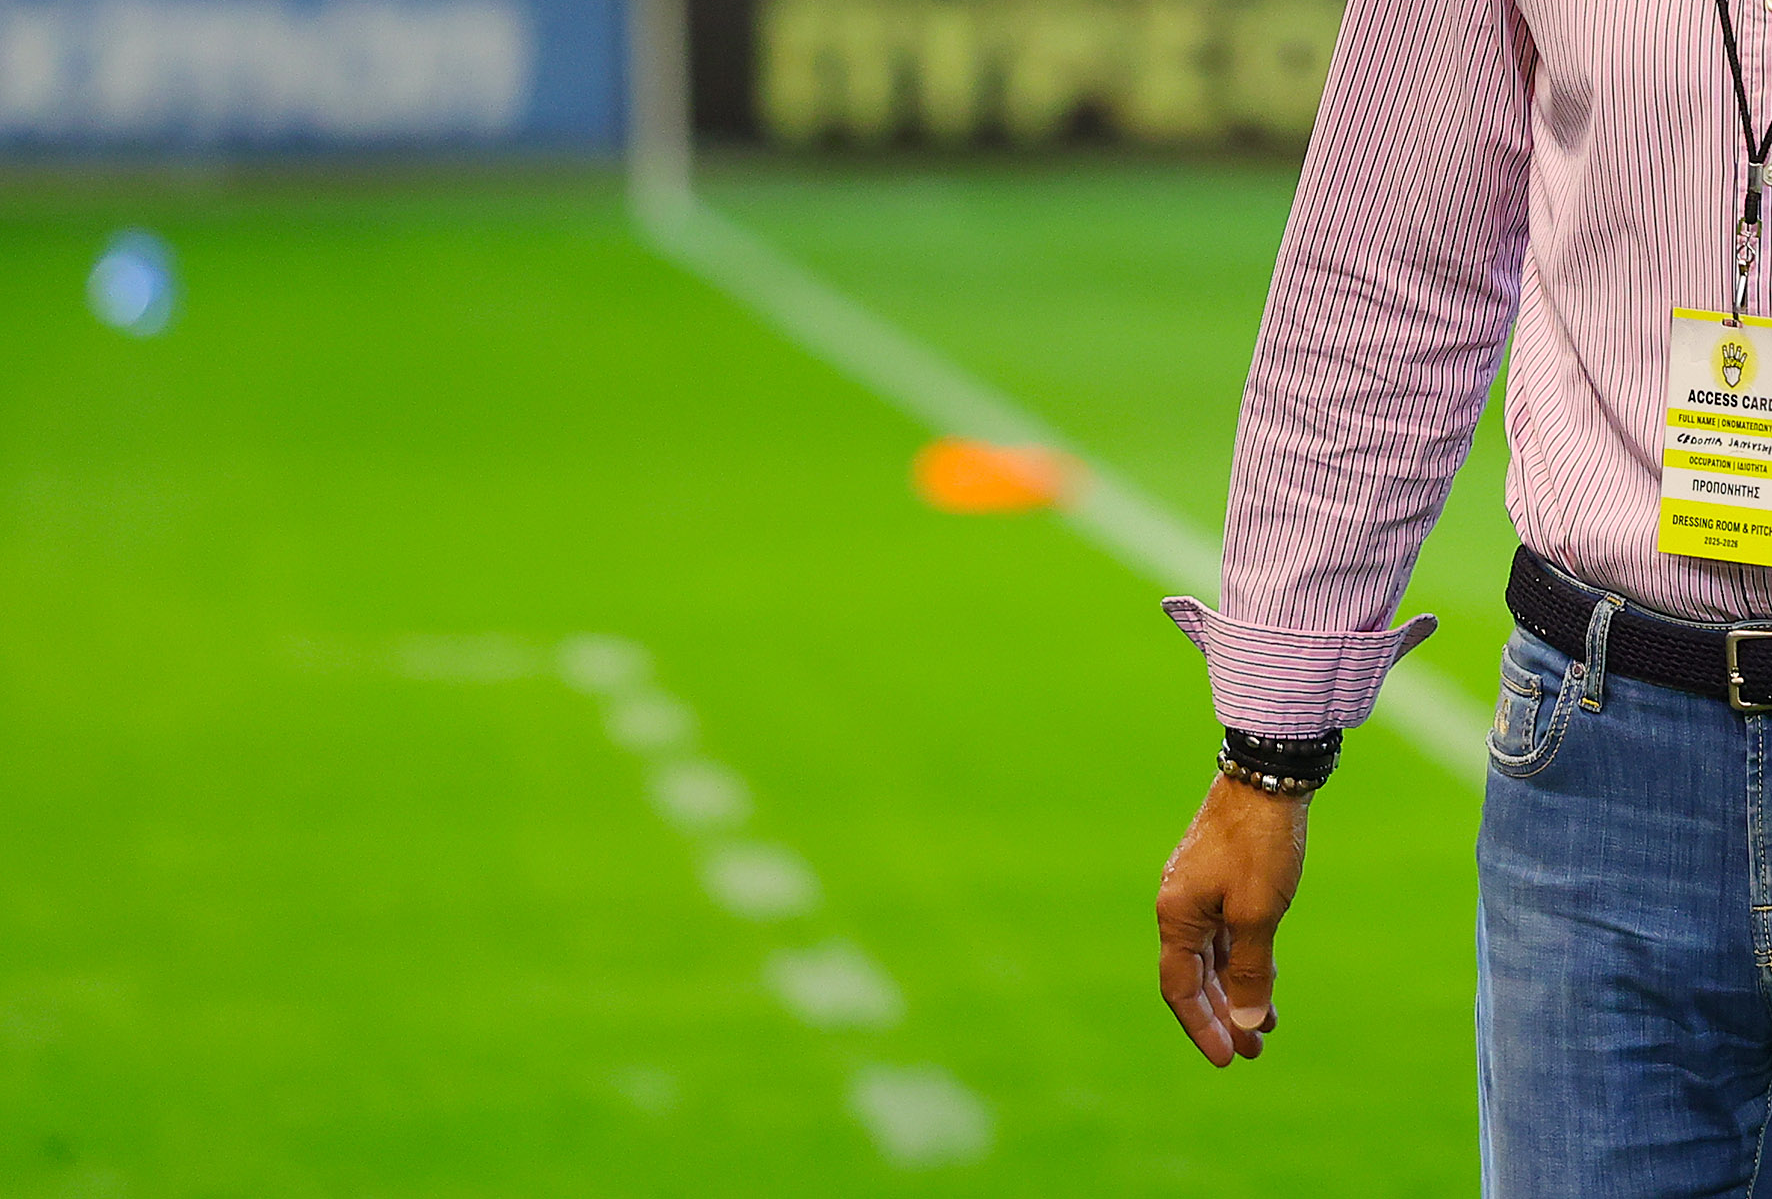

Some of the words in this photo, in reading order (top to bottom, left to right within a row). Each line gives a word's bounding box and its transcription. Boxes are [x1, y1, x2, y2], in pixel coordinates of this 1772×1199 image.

[1688, 389, 1738, 407] ACCESS
[1678, 413, 1695, 424] FULL
[1697, 416, 1716, 426] NAME
[1689, 456, 1731, 469] OCCUPATION
[1737, 462, 1768, 473] ΙΔΙΟΤΗΤΑ
[1692, 479, 1760, 499] ΠΡΟΠΟΝΗΤΗΣ
[1672, 514, 1714, 530] DRESSING
[1716, 519, 1740, 533] ROOM
[1742, 523, 1749, 534] &
[1704, 536, 1739, 548] 2025-2026
